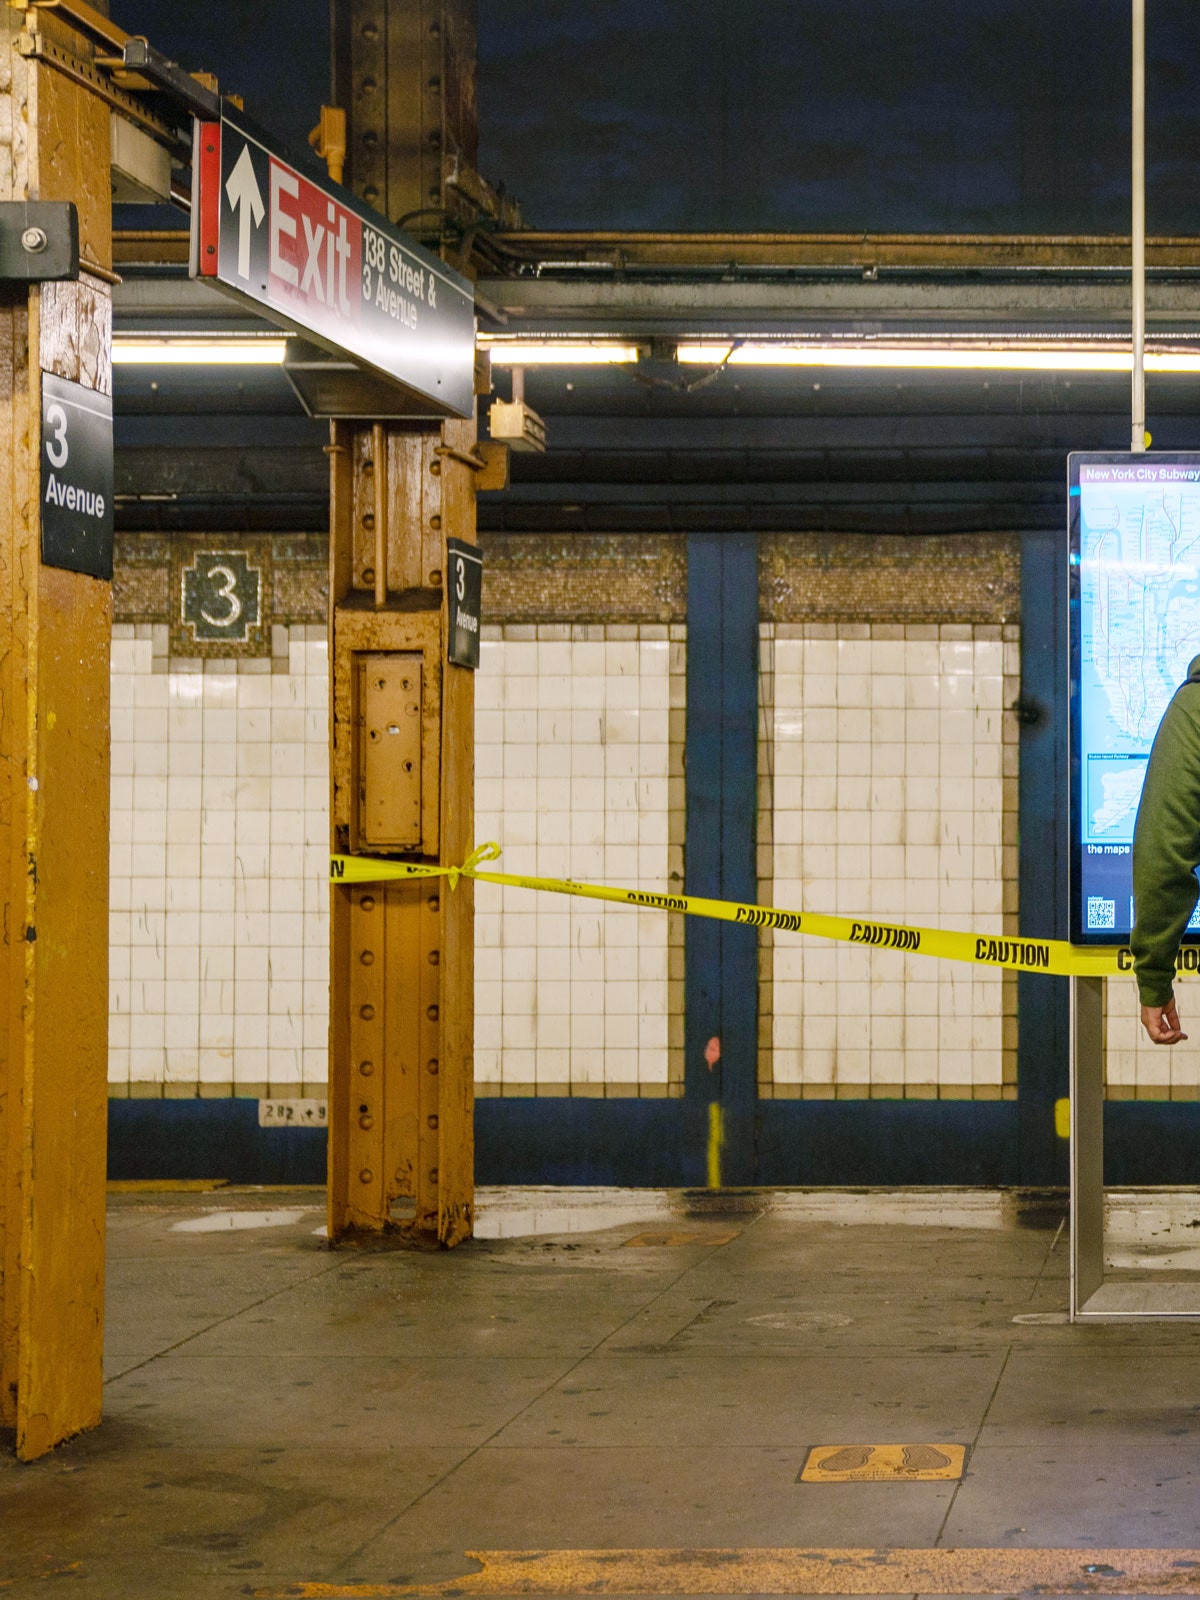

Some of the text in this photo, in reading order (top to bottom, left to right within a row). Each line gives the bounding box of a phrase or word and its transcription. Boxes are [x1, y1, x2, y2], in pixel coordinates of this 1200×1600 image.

[270, 162, 350, 317] Exit
[363, 228, 436, 309] 138 Street &
[363, 265, 418, 330] 3 Avenue
[46, 403, 69, 469] 3
[45, 473, 105, 518] Avenue
[1086, 469, 1200, 481] New York City Subway
[200, 566, 242, 628] 3
[456, 558, 465, 601] 3
[456, 606, 478, 633] Avenue
[1088, 845, 1130, 856] the maps
[736, 908, 802, 931] CAUTION
[850, 923, 920, 950] CAUTION
[975, 938, 1050, 968] CAUTION
